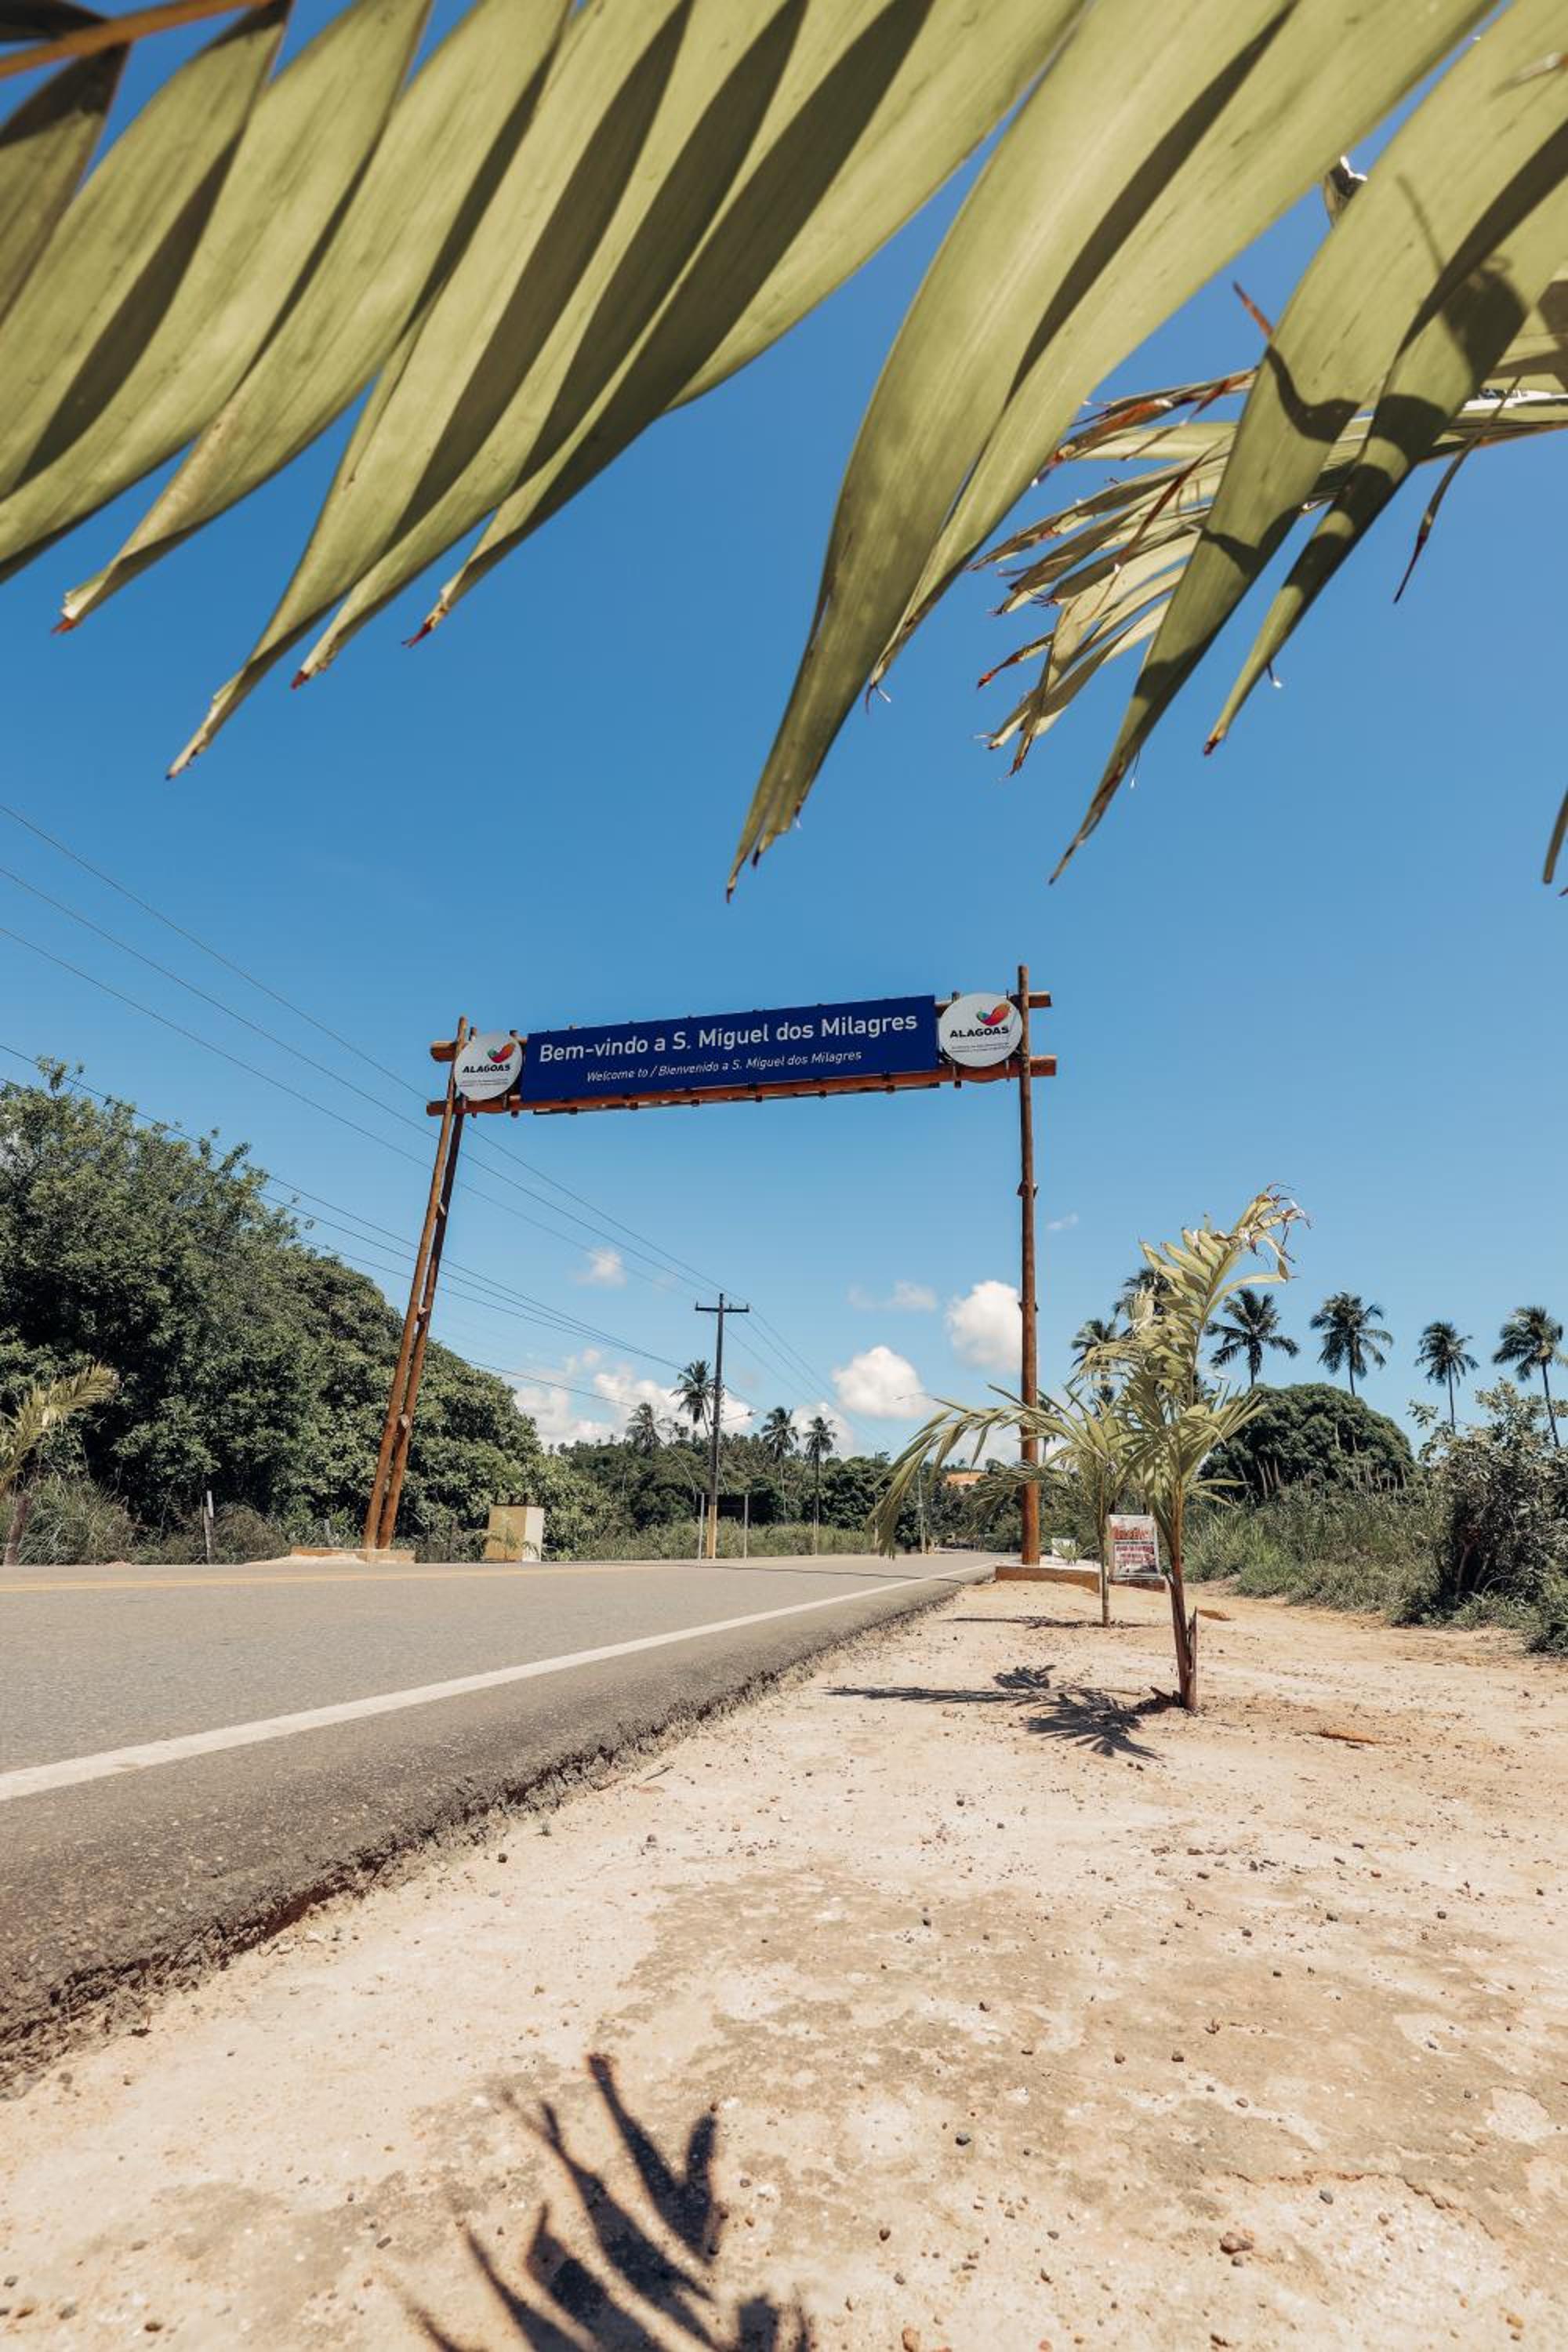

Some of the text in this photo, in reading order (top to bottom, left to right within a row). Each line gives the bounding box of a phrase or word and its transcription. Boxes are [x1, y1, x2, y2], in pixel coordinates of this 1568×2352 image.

[539, 1015, 918, 1062] Bem-vindo a S. Miguel dos Milagres
[949, 1025, 1009, 1038] ALAGOAS
[462, 1063, 510, 1073] ALAGOAS
[587, 1069, 635, 1082] Welcome
[637, 1069, 648, 1078] to
[659, 1061, 719, 1076] Bienvenido
[722, 1062, 728, 1071] a
[732, 1059, 742, 1071] S.
[746, 1054, 784, 1070] Miguel
[788, 1054, 808, 1065] dos
[811, 1051, 862, 1064] Milagres
